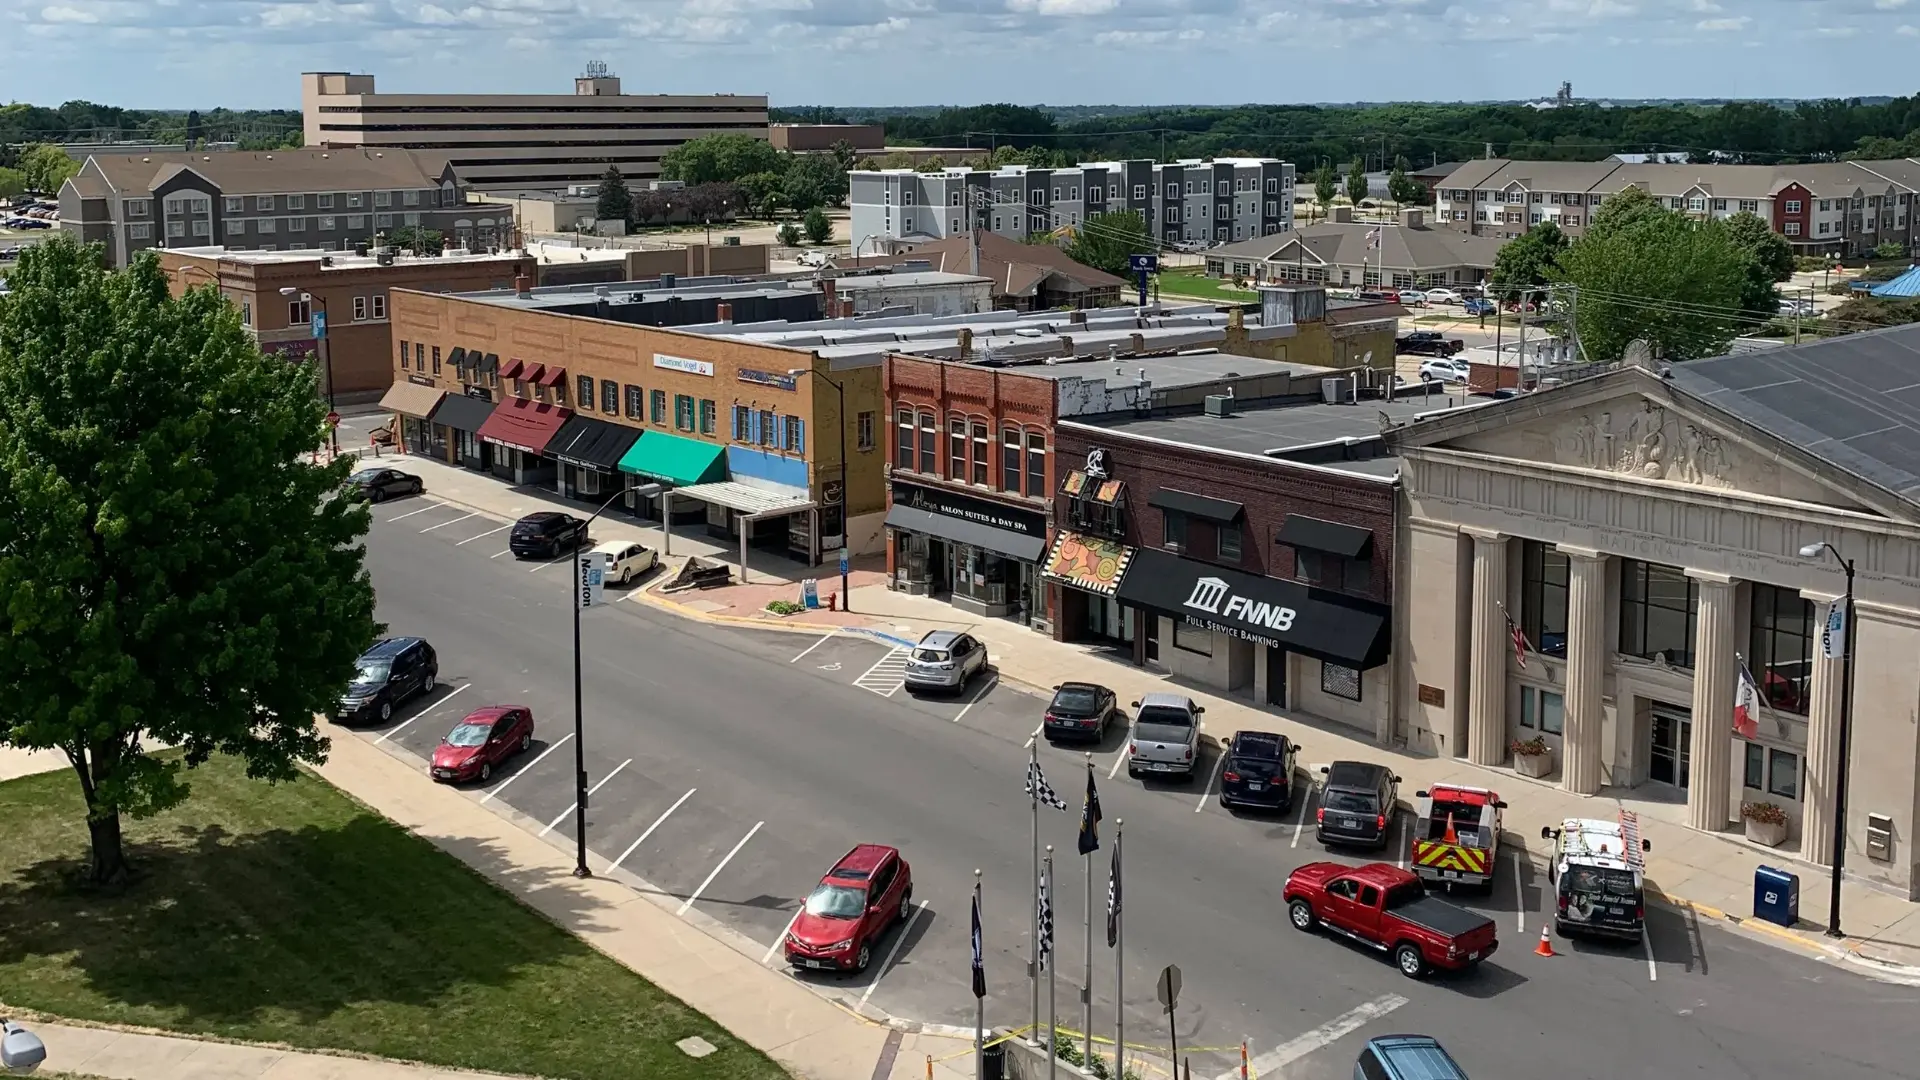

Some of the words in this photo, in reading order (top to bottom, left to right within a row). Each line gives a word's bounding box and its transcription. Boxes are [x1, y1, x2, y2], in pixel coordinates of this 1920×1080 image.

[660, 356, 682, 368] Diamond
[683, 360, 697, 371] Vogel
[940, 504, 964, 516] SALON
[964, 510, 990, 522] SUITES
[990, 516, 997, 524] &
[998, 518, 1013, 527] DAY
[1014, 521, 1027, 531] SPA
[580, 558, 592, 608] Newton
[1222, 594, 1297, 632] FNNB
[1185, 614, 1204, 628] FULL
[1206, 620, 1238, 638] SERVICE
[1240, 629, 1279, 649] BANKING
